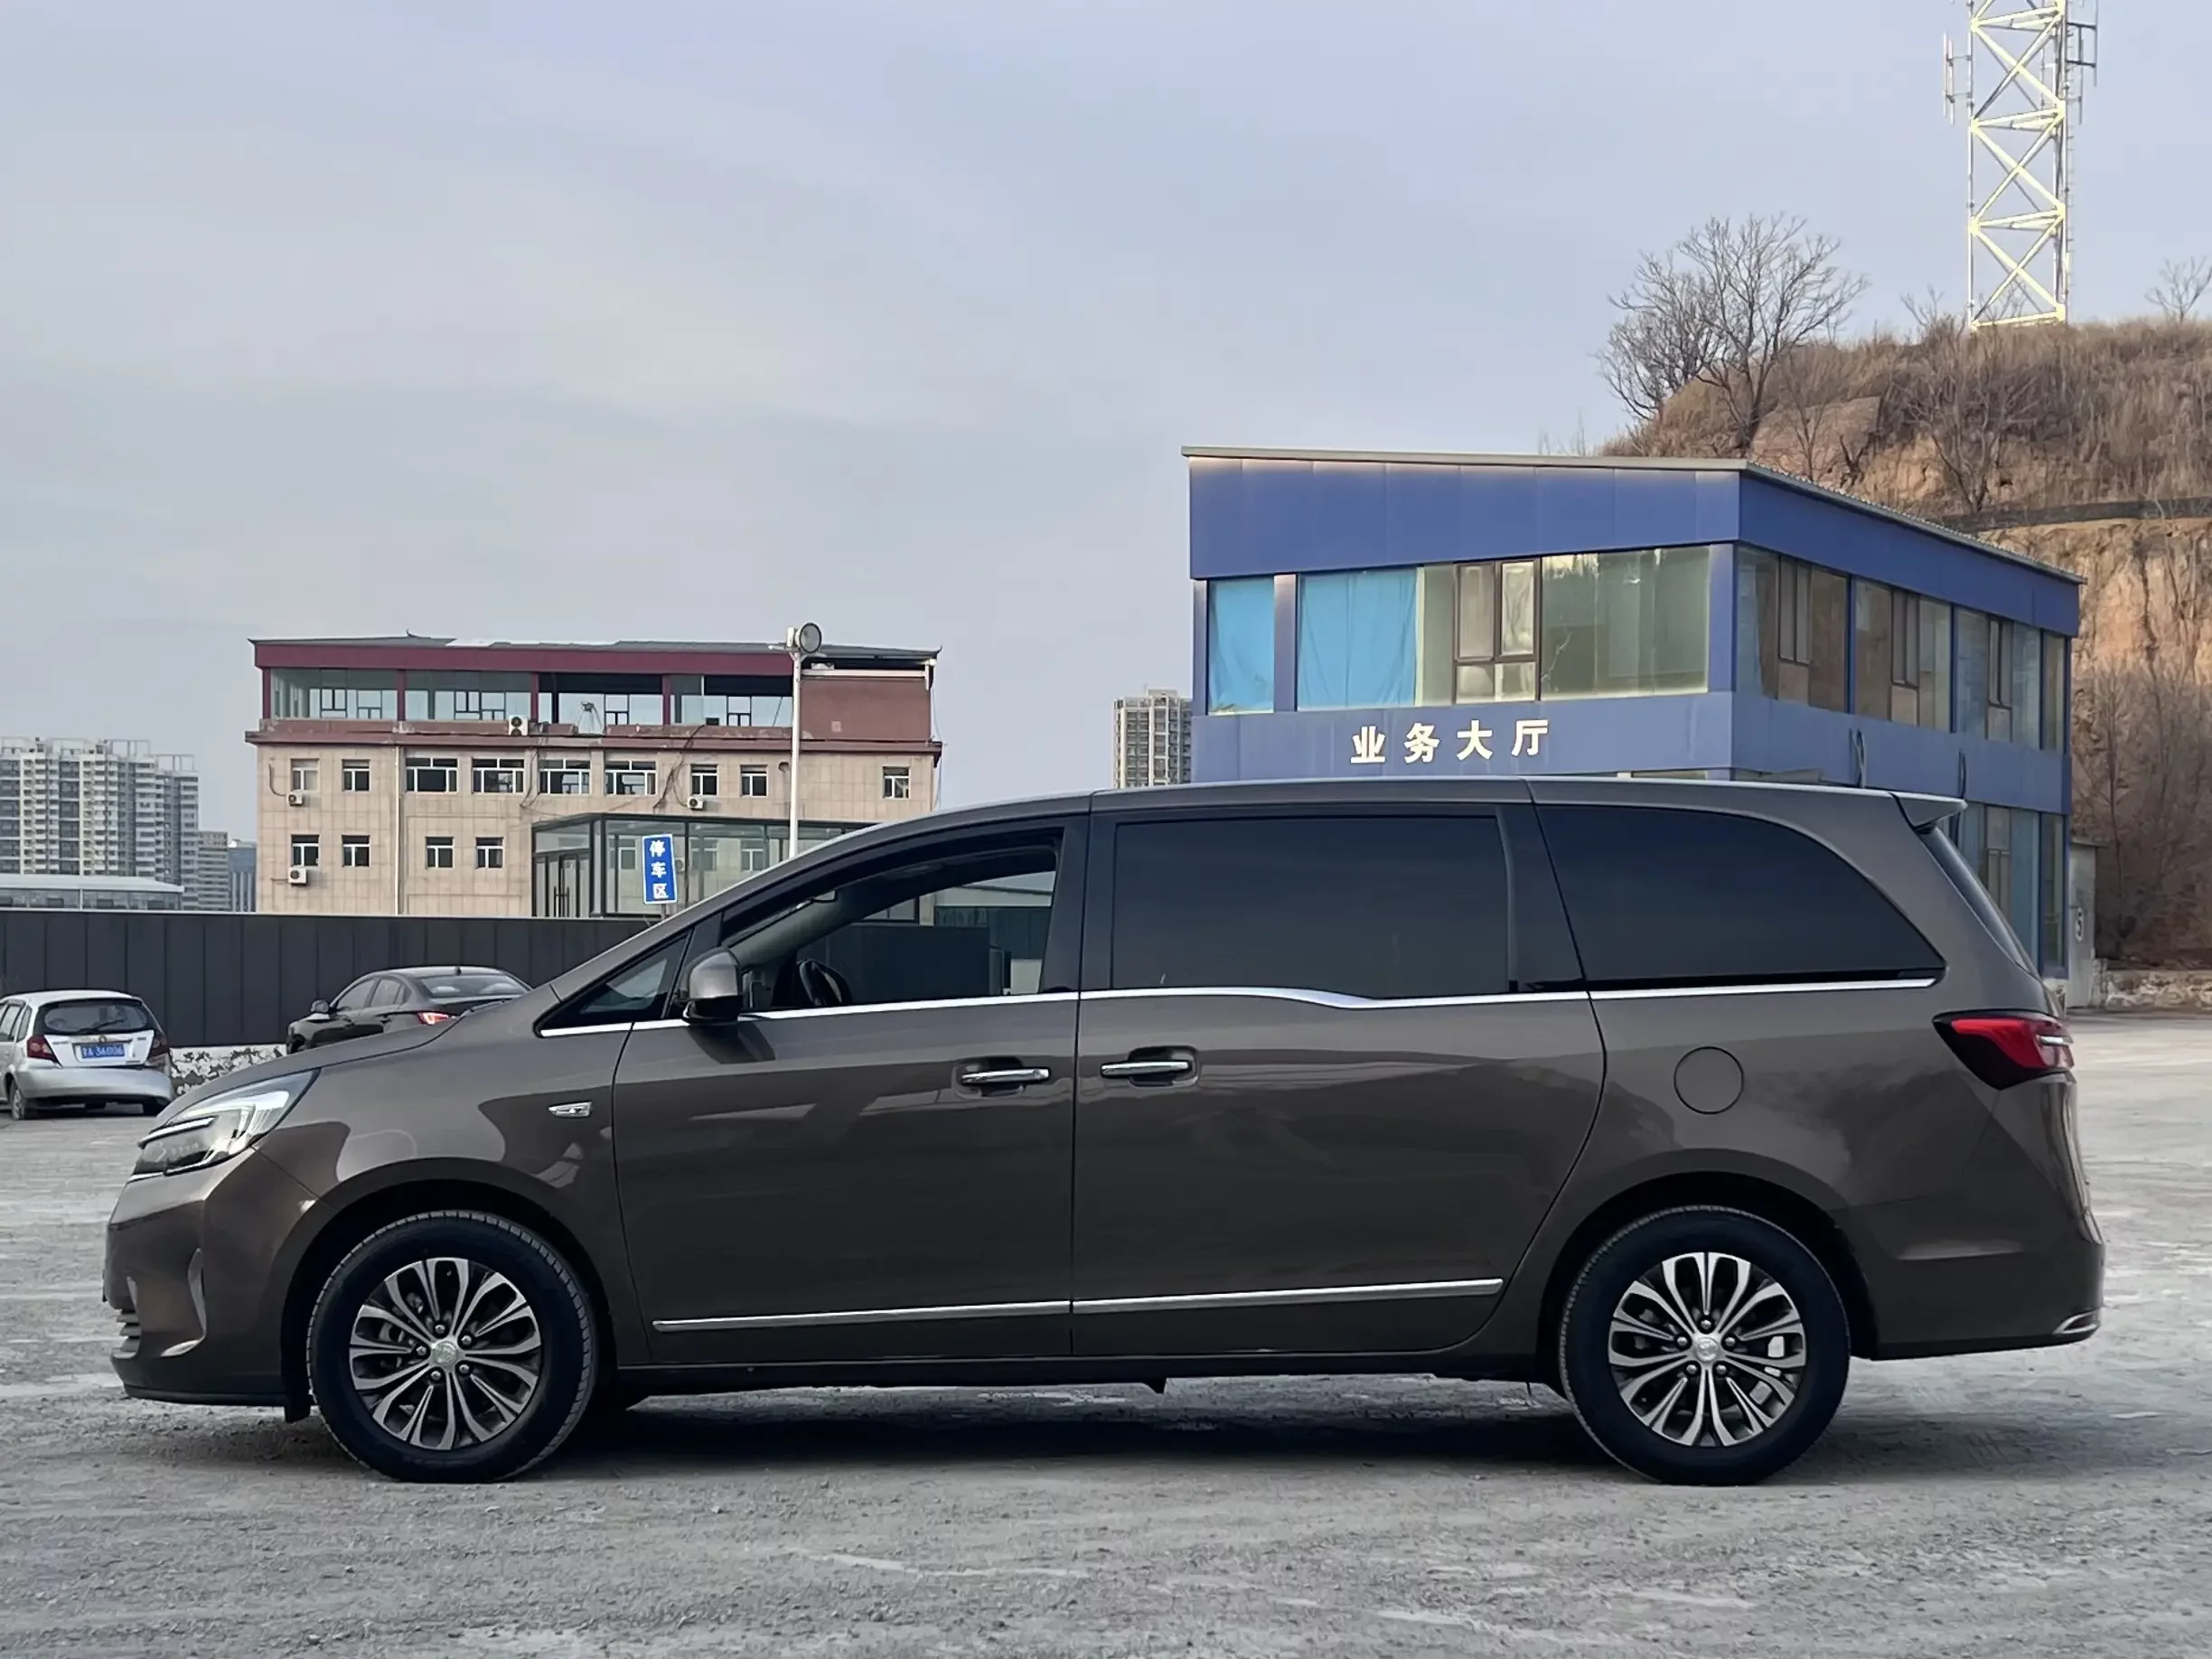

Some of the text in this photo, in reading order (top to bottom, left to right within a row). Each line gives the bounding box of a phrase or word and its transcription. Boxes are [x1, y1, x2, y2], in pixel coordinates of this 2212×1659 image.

[1350, 719, 1549, 764] 业务大厅
[649, 839, 669, 899] 停车区
